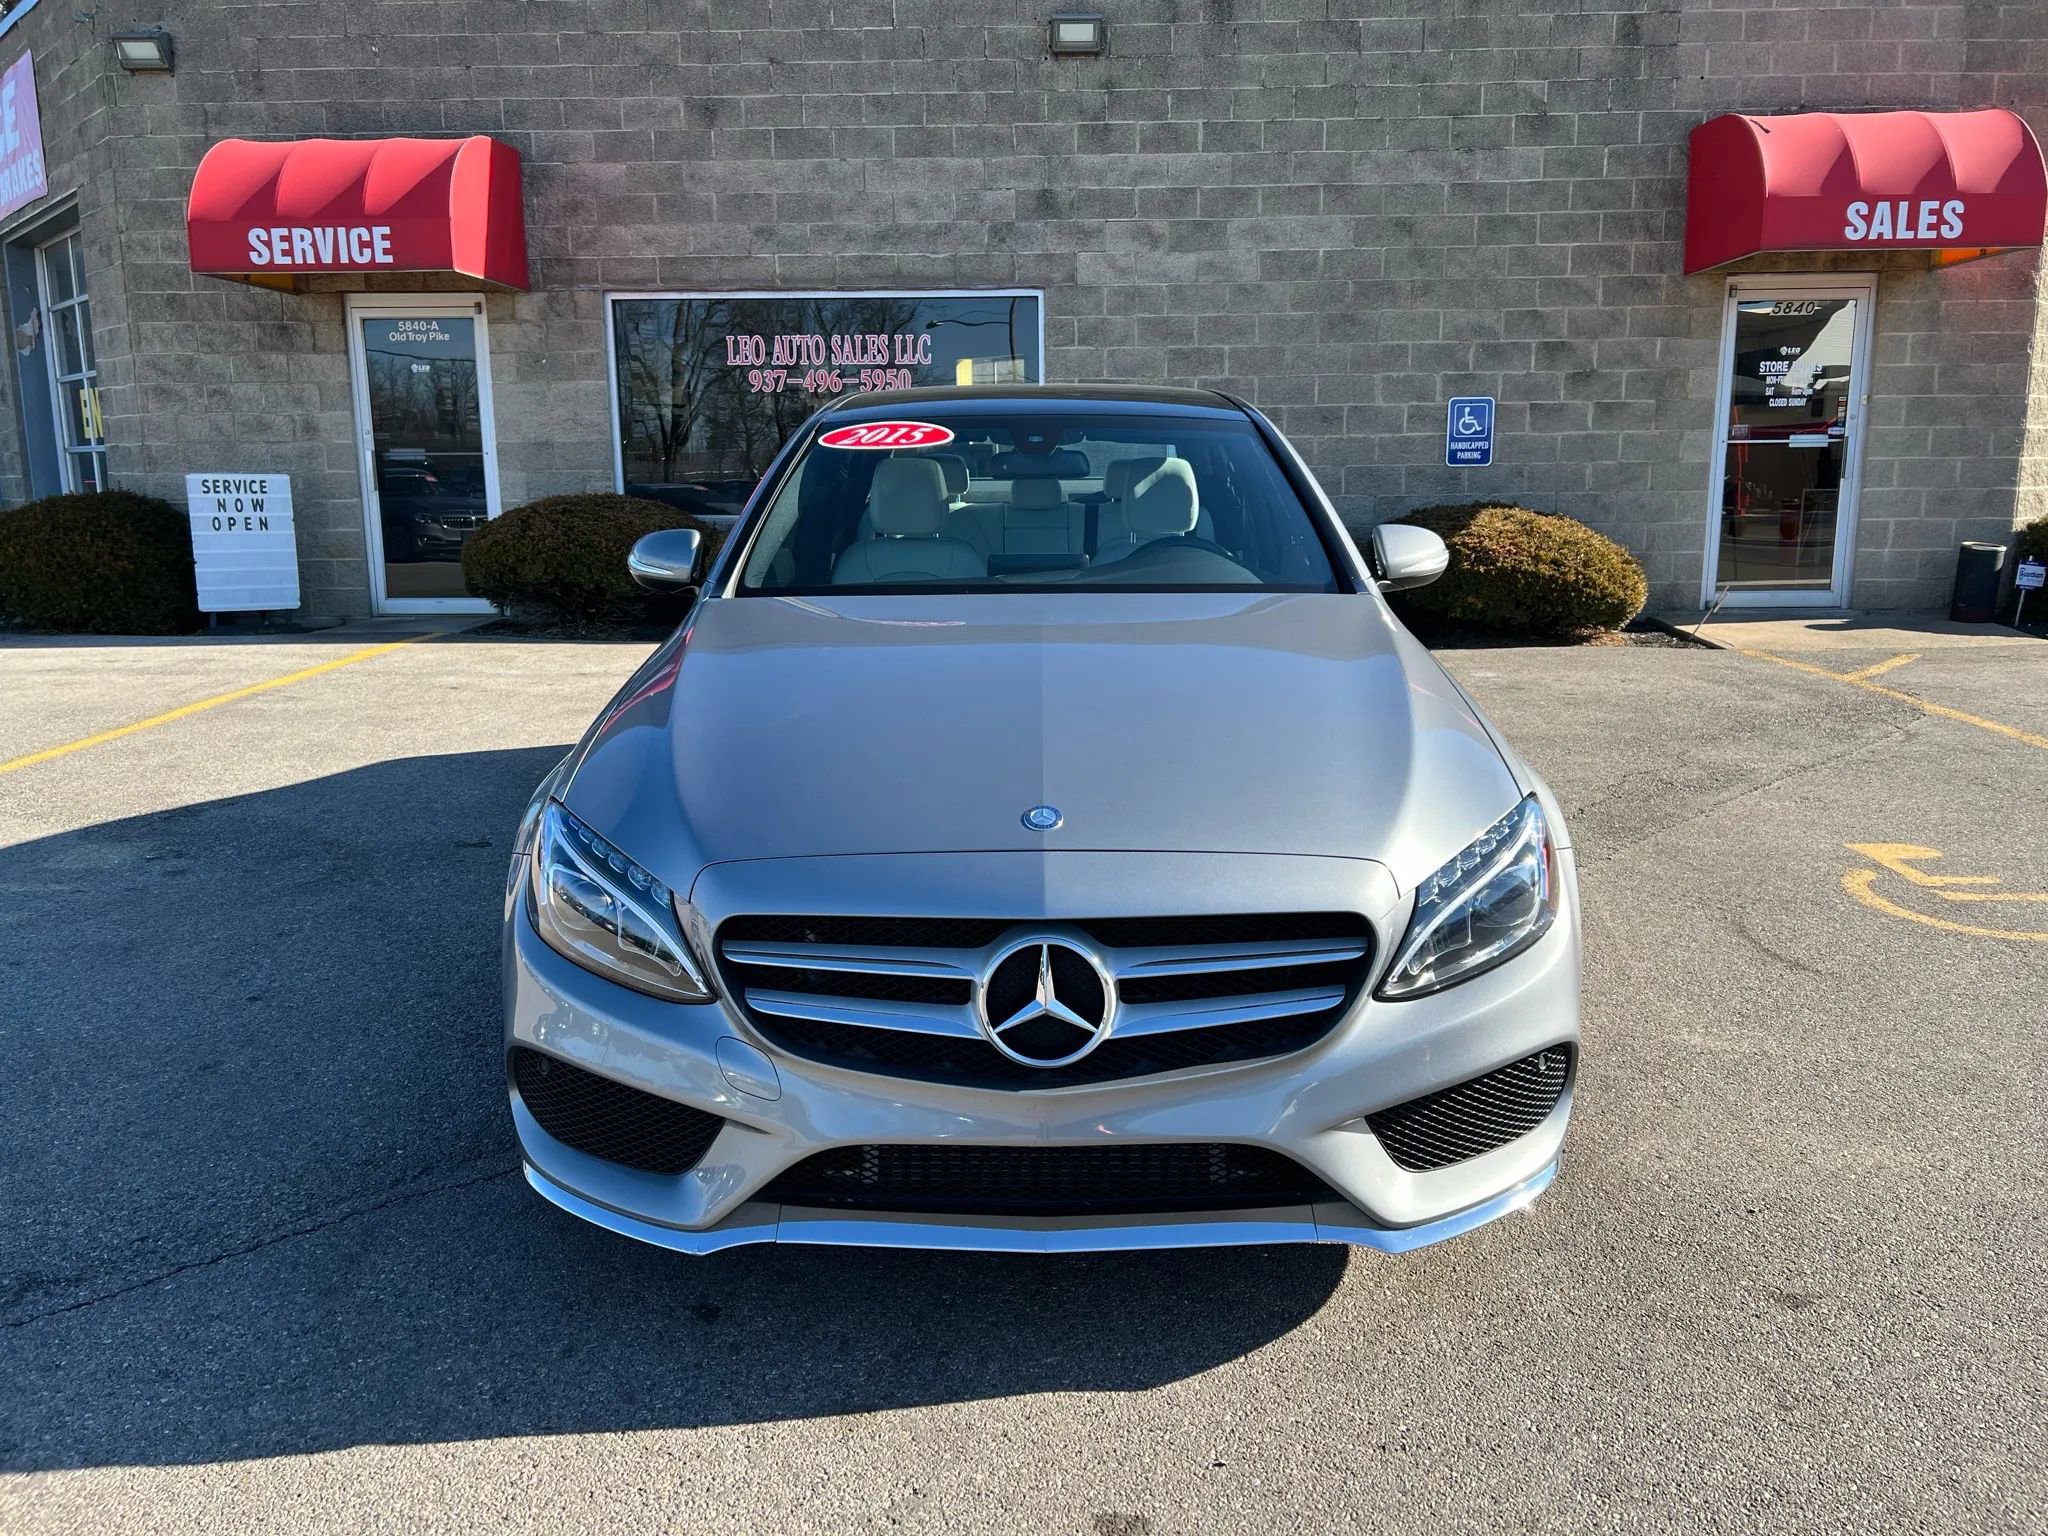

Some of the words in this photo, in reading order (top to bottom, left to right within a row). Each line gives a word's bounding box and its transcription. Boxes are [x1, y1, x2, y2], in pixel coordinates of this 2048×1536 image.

[1844, 200, 1965, 240] SALES
[247, 226, 394, 265] SERVICE
[1771, 301, 1815, 315] 5840
[398, 320, 440, 332] 5840-A
[389, 331, 406, 341] Old
[407, 331, 427, 343] Troy
[429, 331, 451, 341] Pike
[726, 335, 766, 366] LEO
[771, 334, 827, 366] AUTO
[831, 334, 890, 366] SALES
[894, 334, 932, 365] LLC
[1759, 361, 1789, 373] STORE
[748, 368, 913, 394] 937-496-5950
[1769, 398, 1788, 407] CLOSED
[1788, 397, 1808, 407] SUNDAY
[837, 427, 933, 445] 2015
[1450, 441, 1489, 450] HANDICAPPED
[1457, 451, 1482, 460] PARKING
[201, 479, 268, 494] SERVICE
[216, 498, 264, 512] NOW
[212, 516, 269, 531] OPEN
